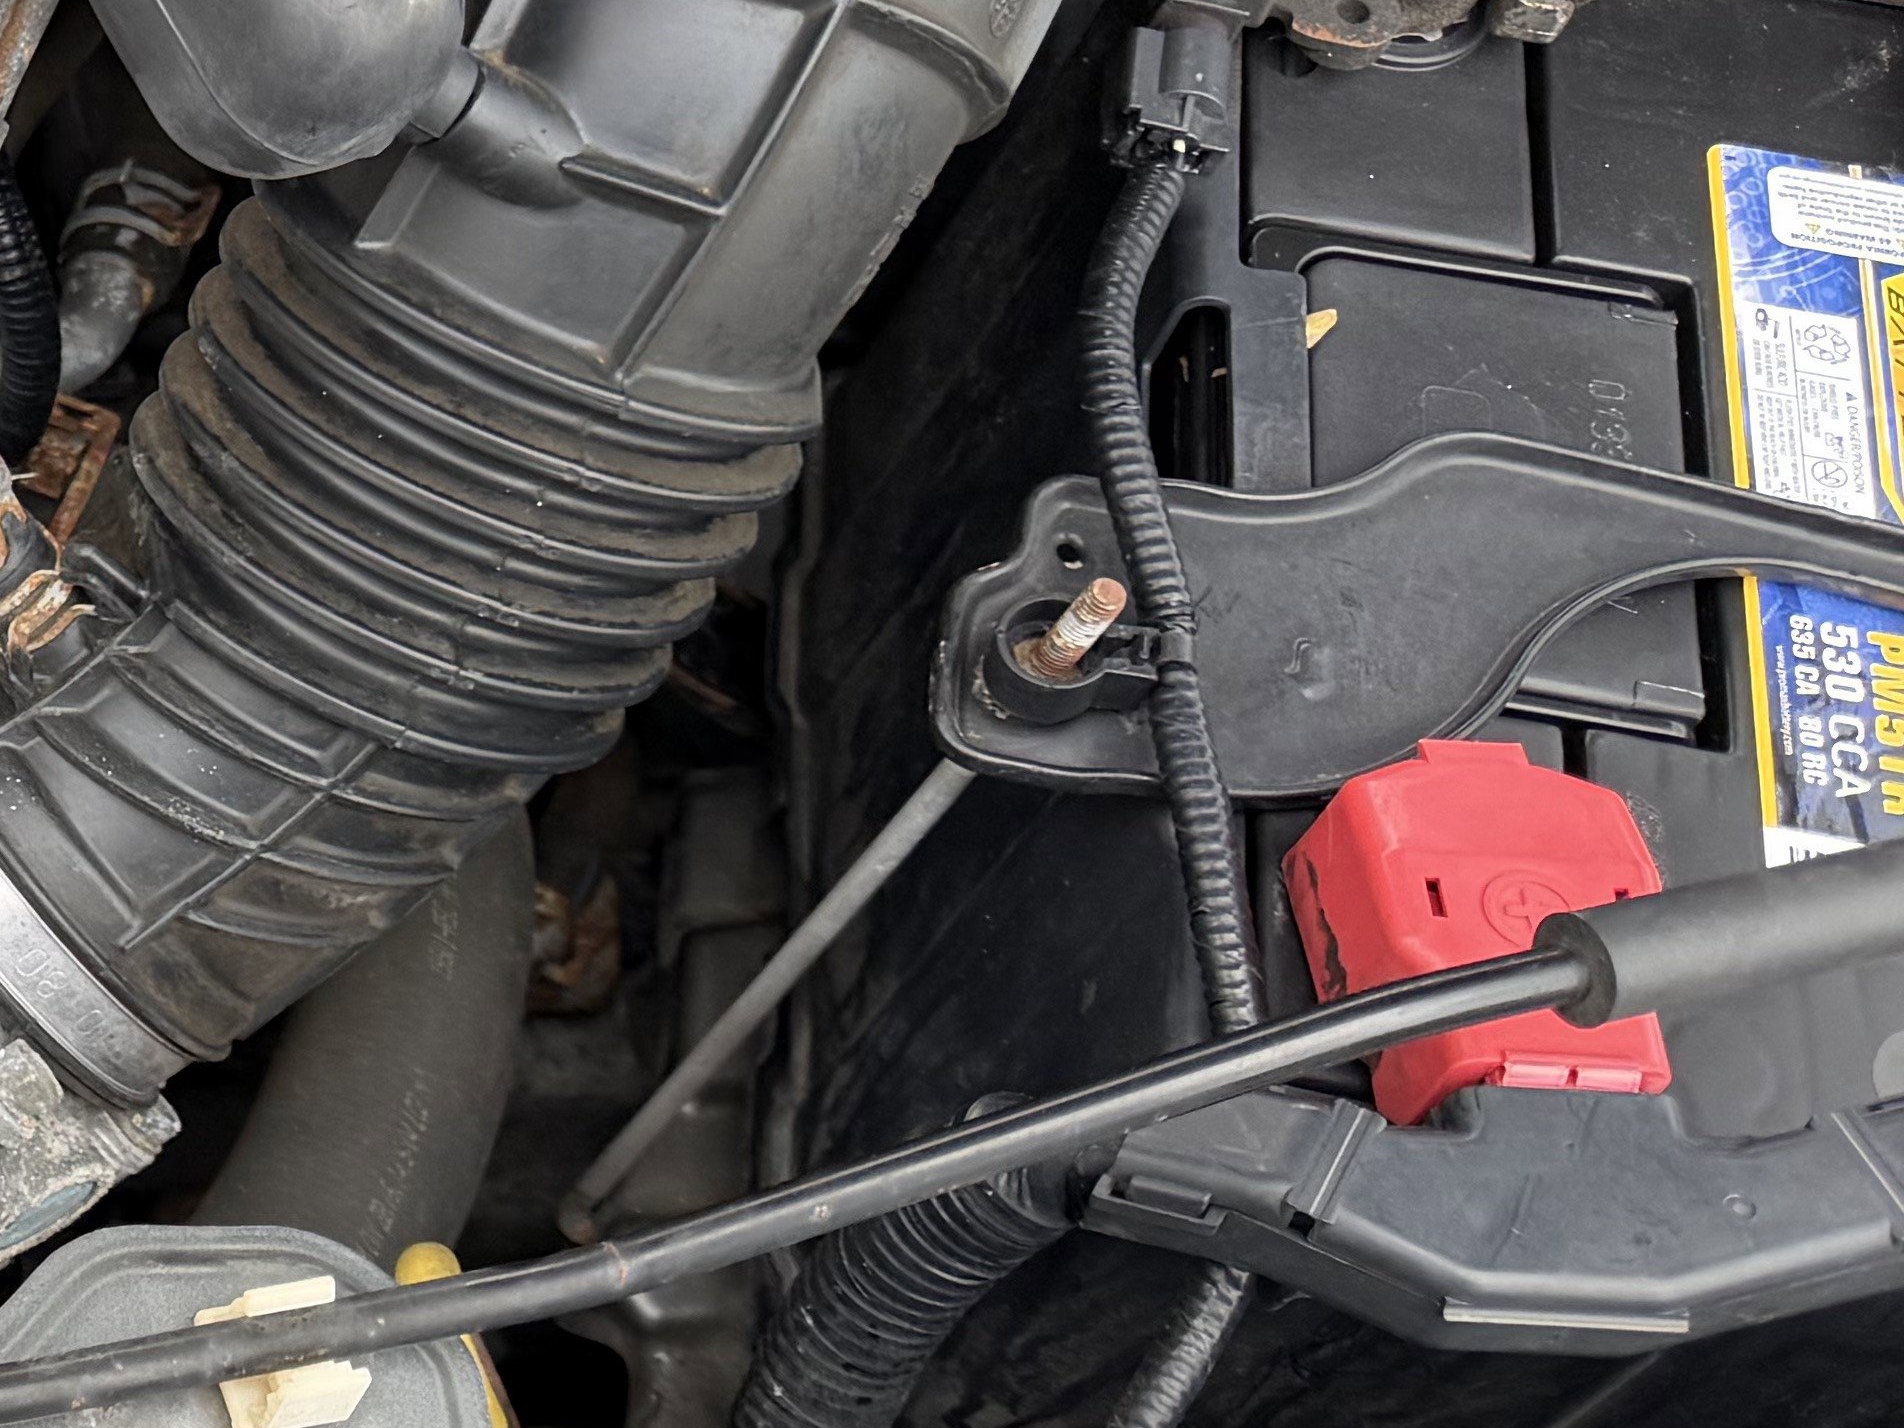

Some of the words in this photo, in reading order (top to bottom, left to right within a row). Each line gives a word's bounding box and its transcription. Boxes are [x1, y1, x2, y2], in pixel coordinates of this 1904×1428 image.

[1789, 614, 1816, 659] 635
[1794, 663, 1820, 696] CA
[1819, 621, 1865, 703] 530
[1798, 715, 1826, 747] 80
[1802, 750, 1828, 787] RC
[1828, 714, 1872, 798] CCA
